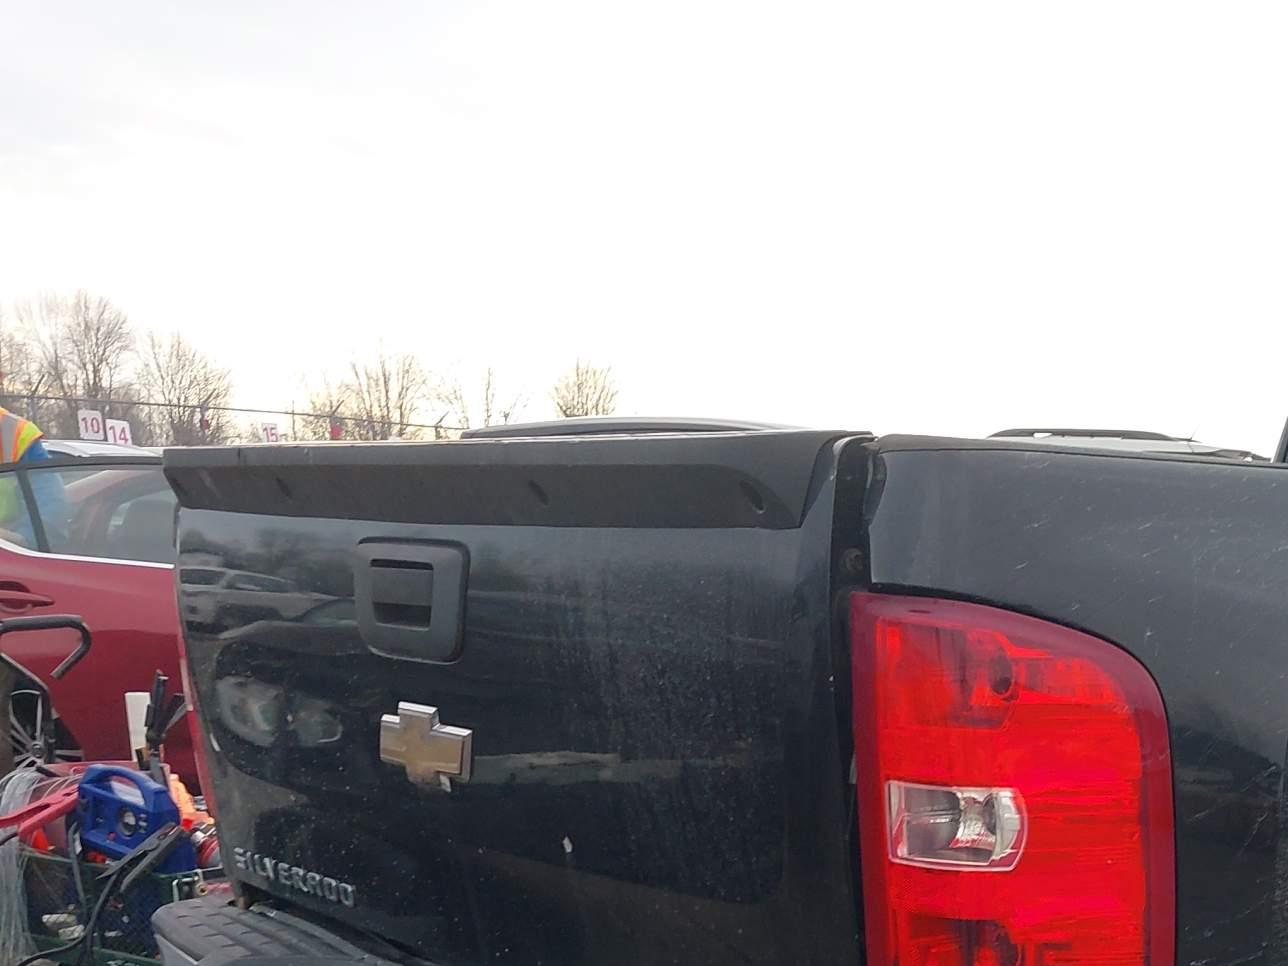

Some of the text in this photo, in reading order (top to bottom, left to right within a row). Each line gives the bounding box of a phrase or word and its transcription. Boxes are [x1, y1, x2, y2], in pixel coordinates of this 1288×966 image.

[80, 416, 101, 434] 10
[263, 426, 279, 443] 15
[109, 425, 130, 445] 14
[233, 846, 356, 908] SILVERADO
